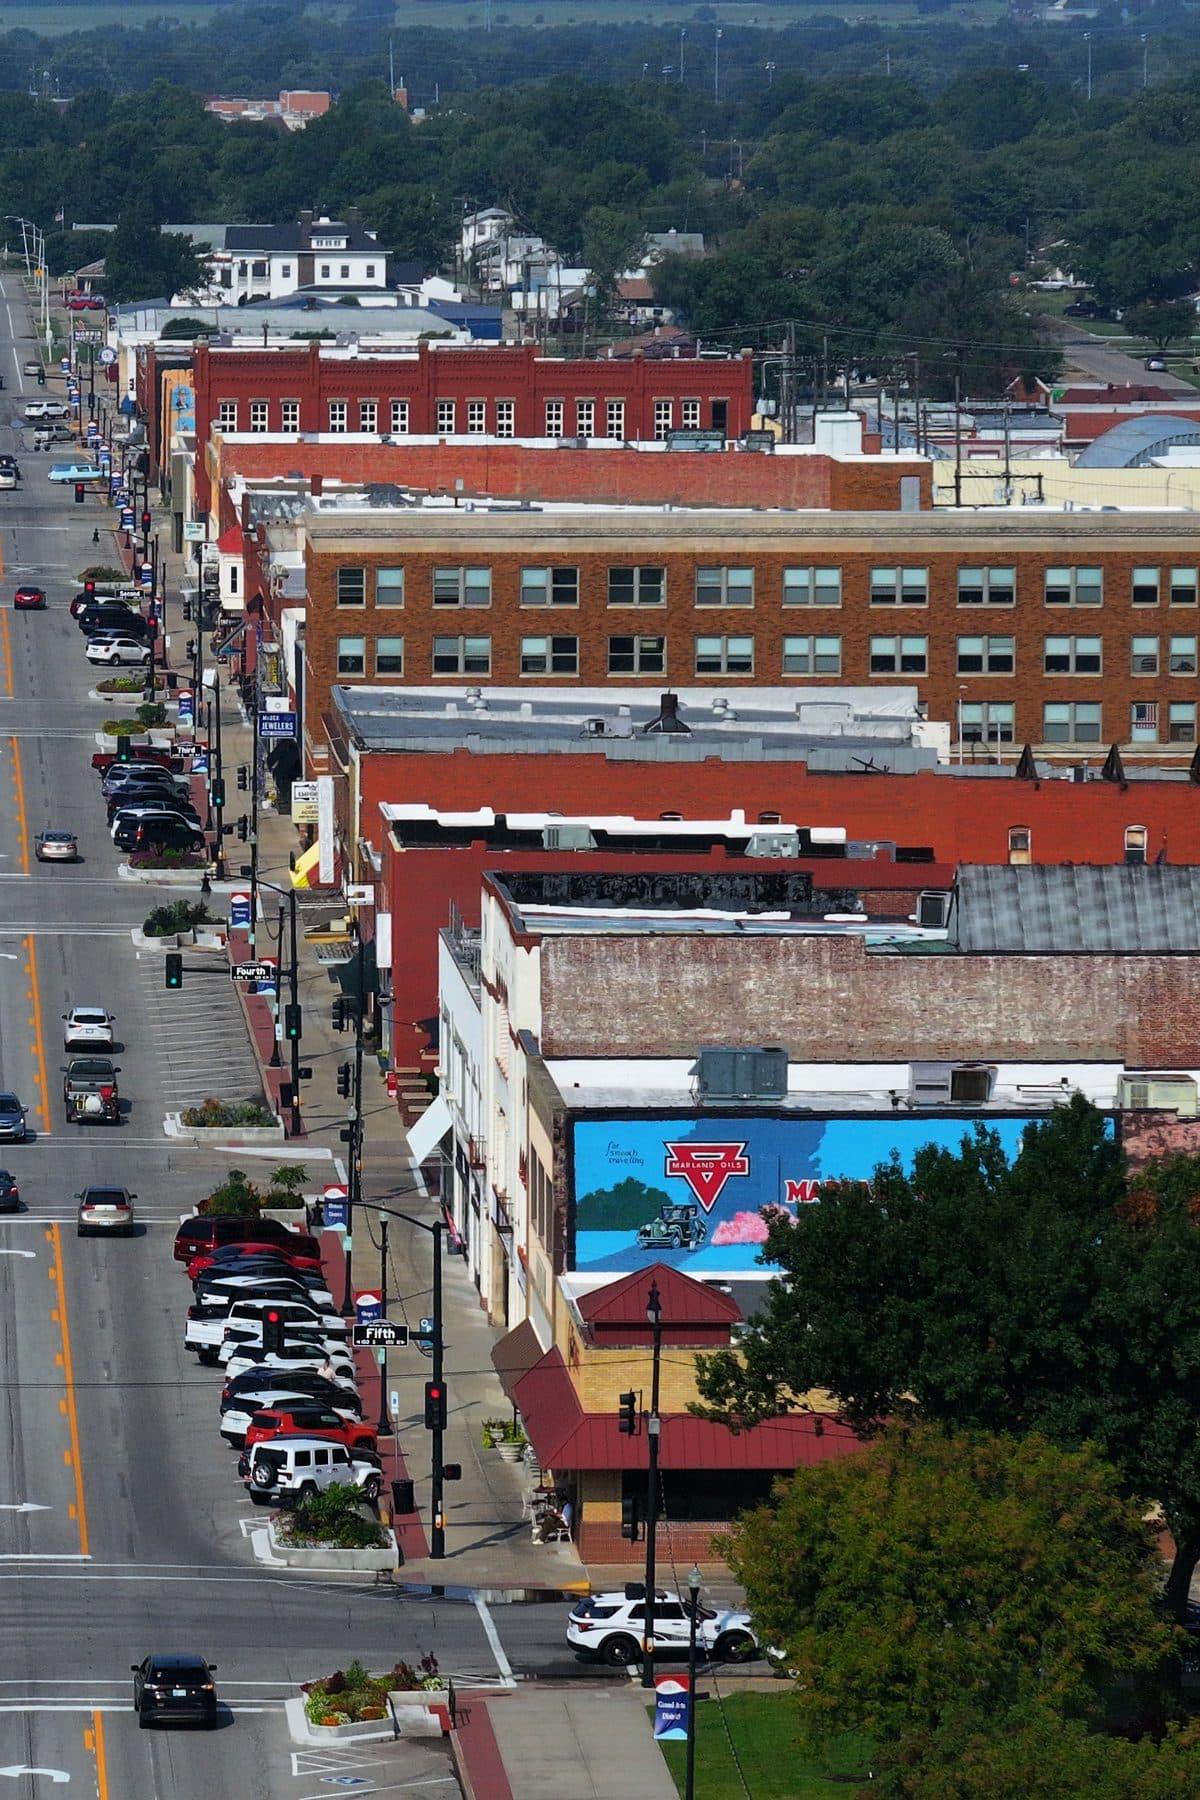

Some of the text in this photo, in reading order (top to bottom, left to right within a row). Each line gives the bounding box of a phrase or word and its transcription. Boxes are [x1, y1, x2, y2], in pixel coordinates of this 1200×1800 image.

[261, 722, 294, 730] JEWELERS
[177, 746, 196, 754] Third
[236, 967, 266, 976] Fourth
[606, 1141, 620, 1157] for
[366, 1328, 396, 1339] Fifth
[658, 1701, 675, 1709] Grand
